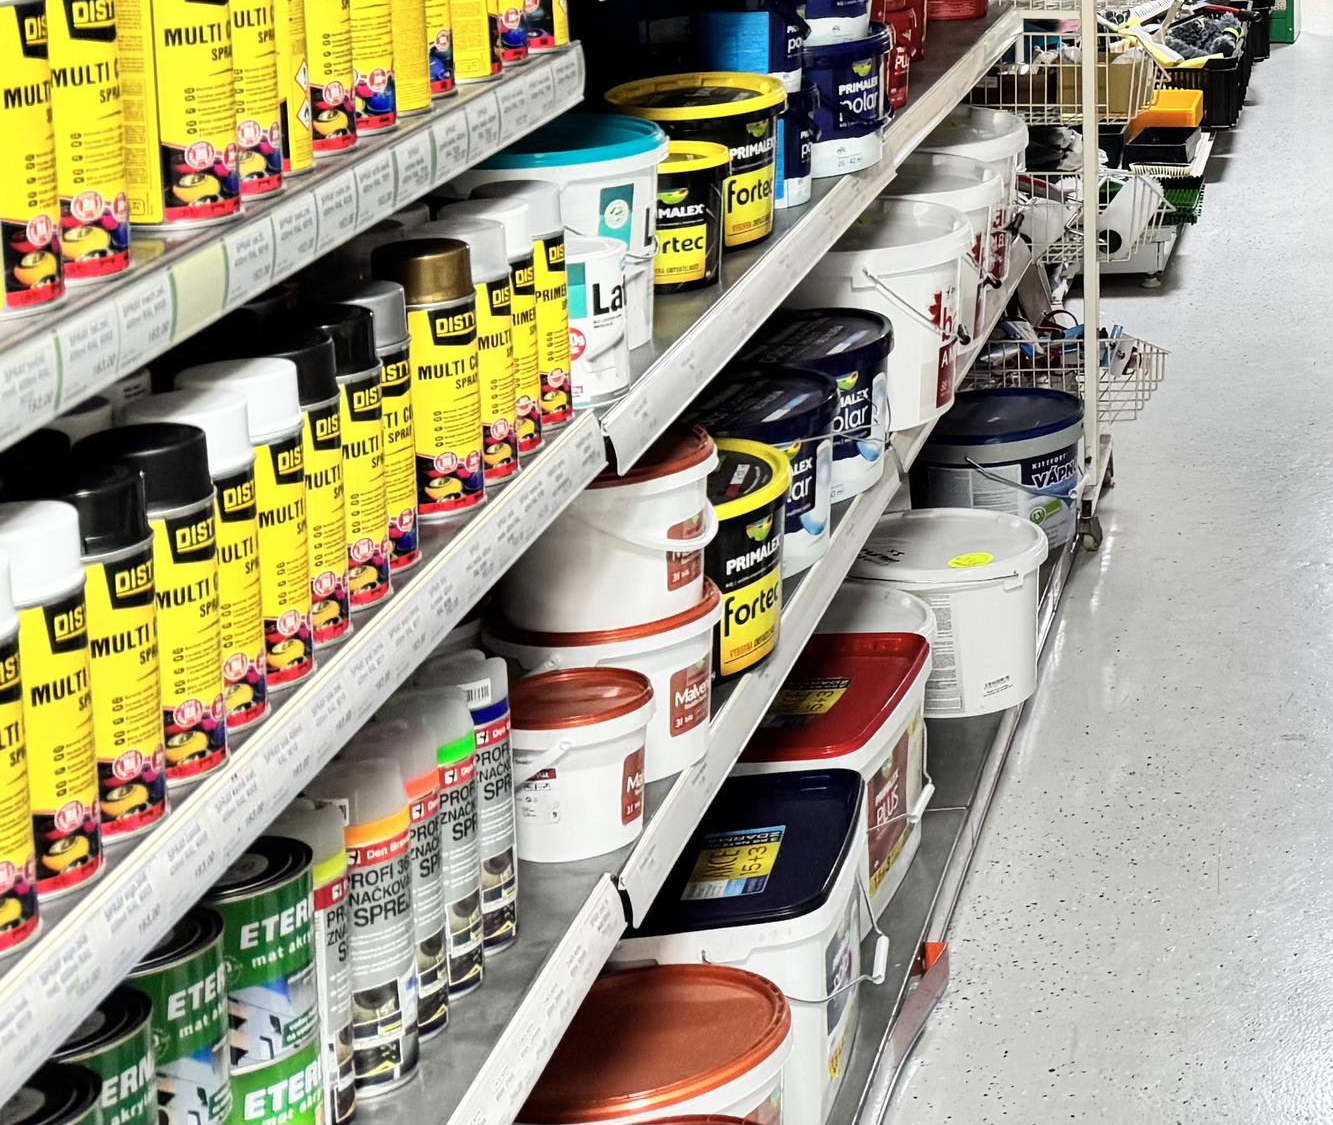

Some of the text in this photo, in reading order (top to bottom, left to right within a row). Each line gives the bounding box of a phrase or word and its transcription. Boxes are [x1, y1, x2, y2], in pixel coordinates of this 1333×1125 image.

[164, 22, 222, 47] MULTI
[839, 75, 878, 95] PRIMALEX
[658, 203, 705, 218] MALEX
[662, 236, 703, 254] rtec
[535, 283, 567, 304] PRIME
[418, 356, 466, 382] MULTI
[832, 404, 868, 433] olar
[1032, 459, 1077, 490] VÁPN
[223, 481, 255, 511] DIST
[175, 519, 215, 550] DIST
[114, 562, 153, 594] DIST
[91, 623, 150, 659] MULTI
[240, 897, 310, 950] ETER
[252, 945, 284, 968] mat
